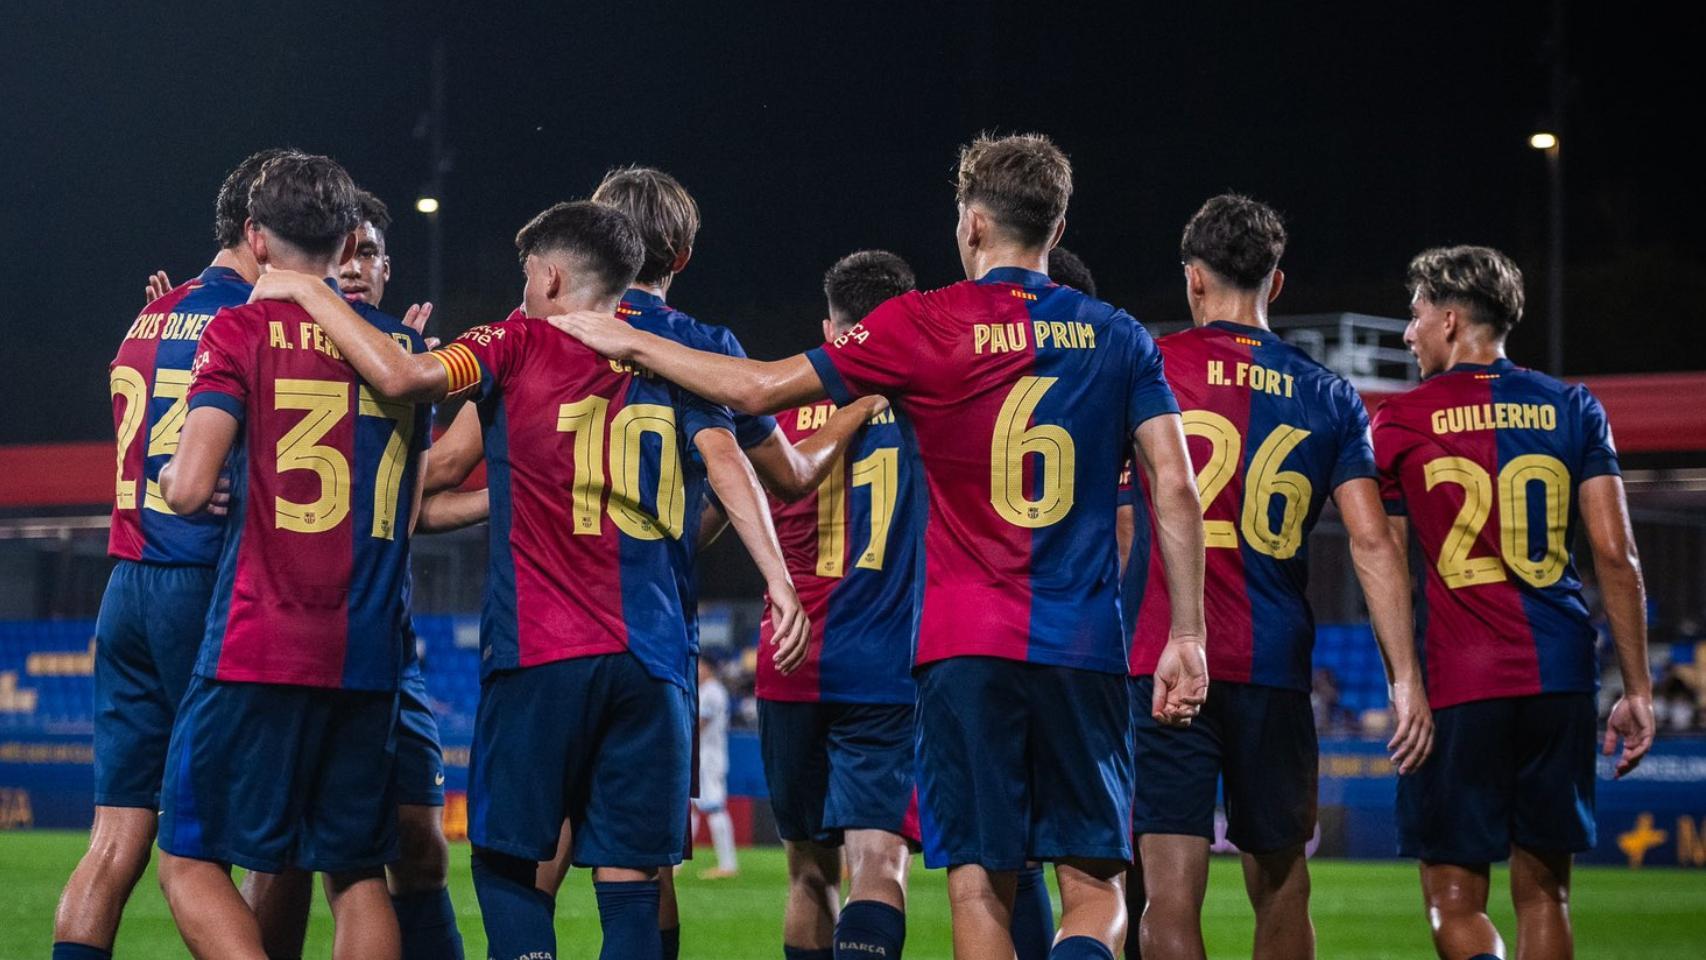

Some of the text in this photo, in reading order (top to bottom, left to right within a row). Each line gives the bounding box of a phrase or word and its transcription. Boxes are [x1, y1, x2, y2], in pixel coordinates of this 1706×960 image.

[269, 321, 293, 349] A.
[973, 321, 1096, 354] PAU PRIM
[1207, 361, 1294, 398] H. FORT
[110, 366, 191, 515] 23
[274, 378, 415, 541] 37
[556, 394, 686, 541] 10
[990, 376, 1076, 528] 6
[1182, 410, 1312, 559] 26
[1431, 403, 1556, 434] GUILLERMO
[816, 447, 899, 578] 11
[1424, 454, 1571, 589] 20
